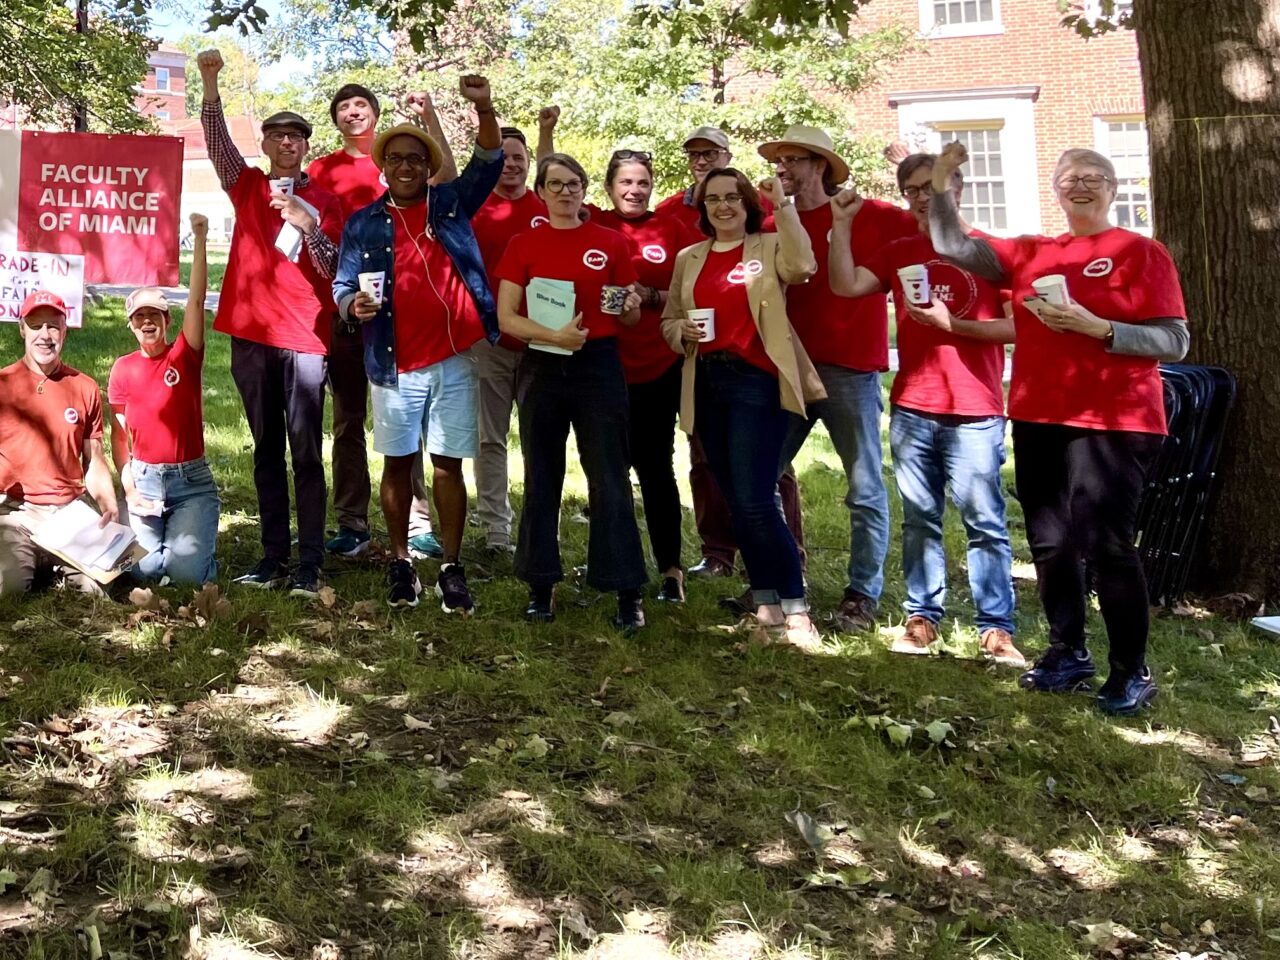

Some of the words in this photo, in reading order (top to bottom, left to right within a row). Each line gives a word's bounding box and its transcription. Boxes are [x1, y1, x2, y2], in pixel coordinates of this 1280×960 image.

[41, 163, 149, 186] FACULTY
[39, 188, 160, 211] ALLIANCE
[39, 211, 72, 231] OF
[79, 213, 156, 236] MIAMI
